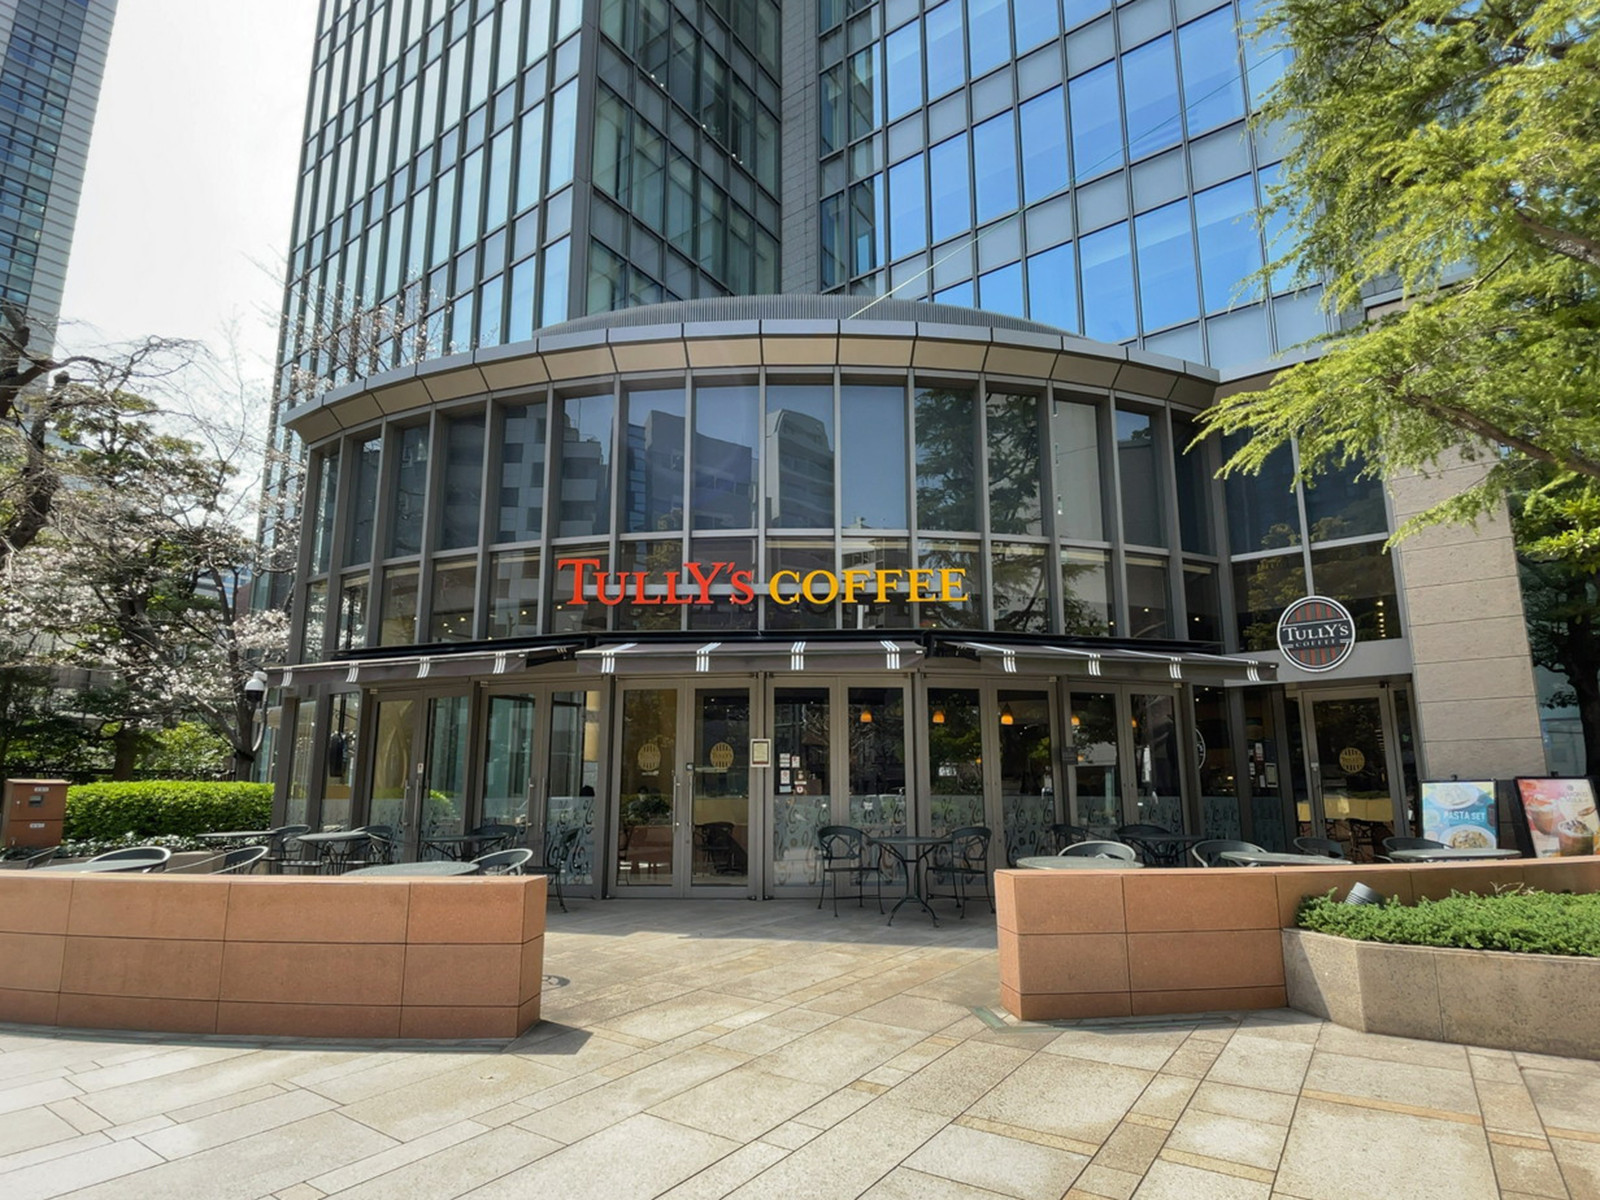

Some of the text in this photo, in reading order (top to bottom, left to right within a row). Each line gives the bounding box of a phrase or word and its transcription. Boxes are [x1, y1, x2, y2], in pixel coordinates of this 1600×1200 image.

[557, 558, 969, 606] TULLY'S COFFEE
[1443, 810, 1469, 821] PASTA
[1470, 812, 1485, 822] SET
